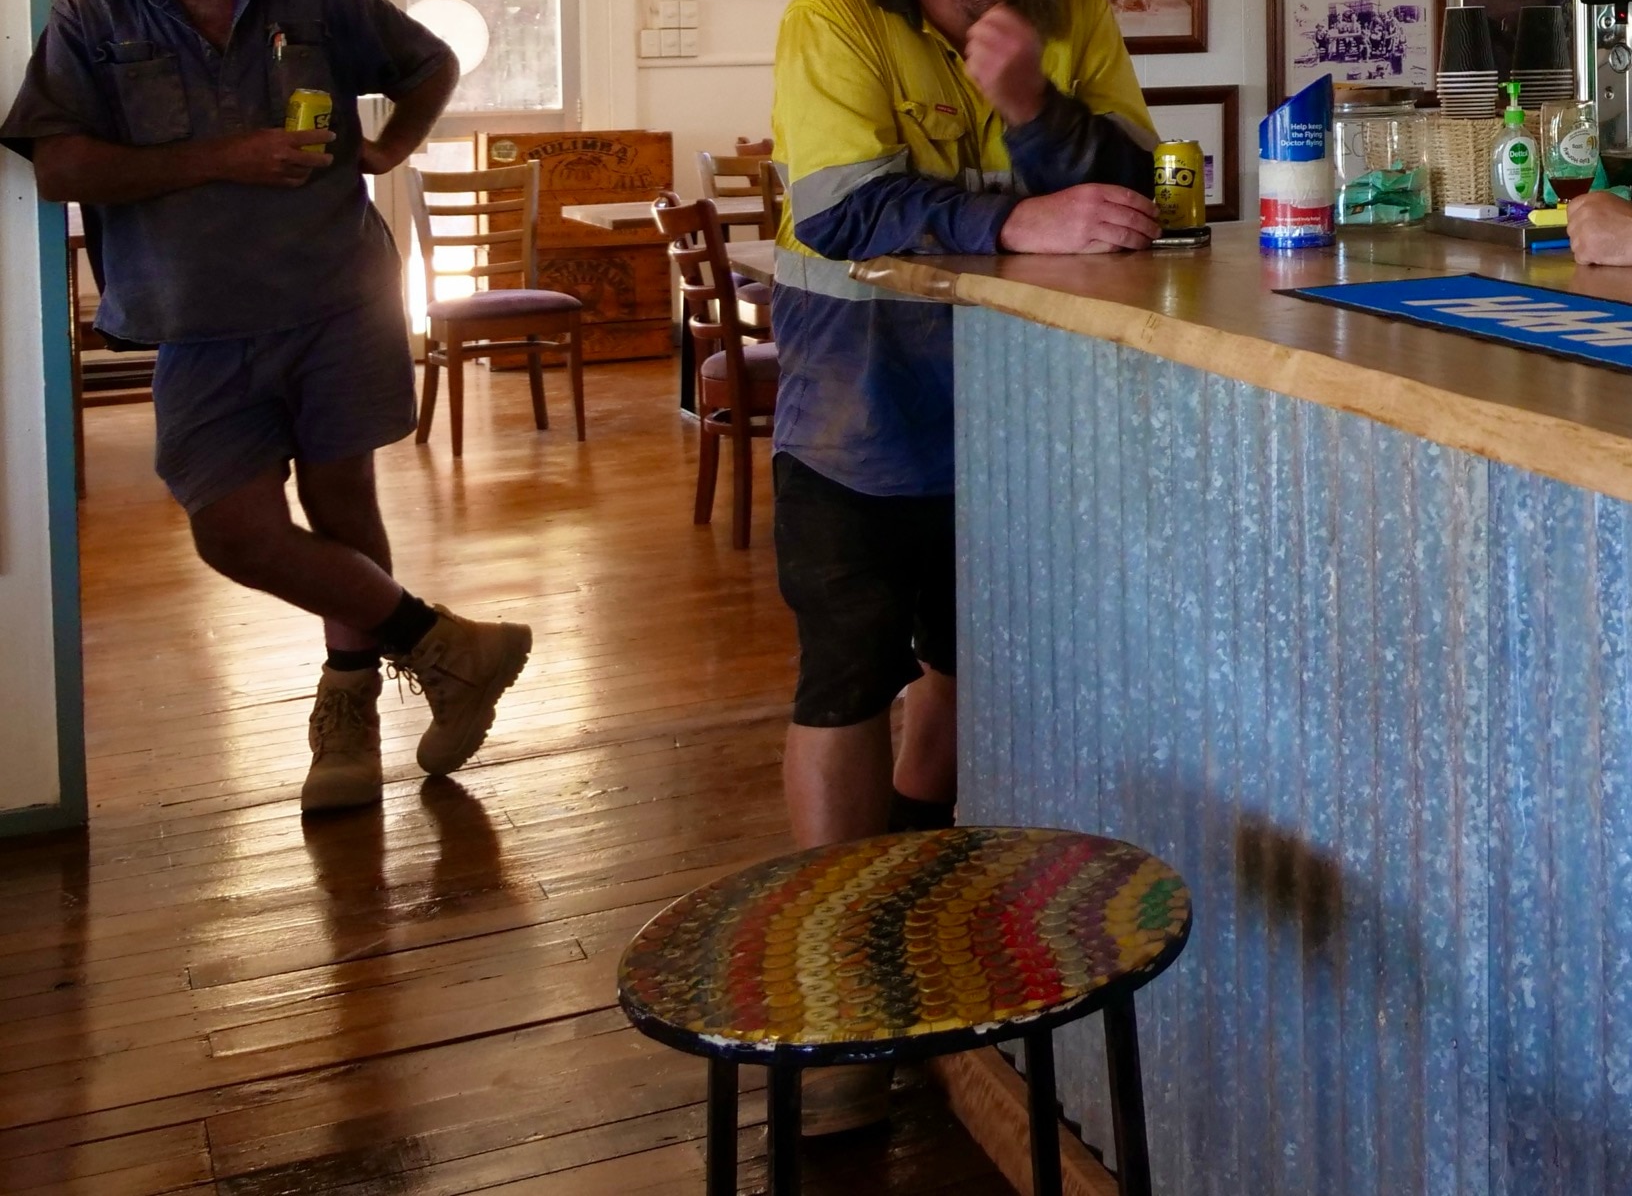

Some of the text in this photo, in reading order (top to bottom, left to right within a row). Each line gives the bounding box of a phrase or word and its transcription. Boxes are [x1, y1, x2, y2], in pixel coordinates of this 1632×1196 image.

[1290, 123, 1323, 131] Help keep
[1304, 131, 1323, 139] Flying
[1306, 139, 1323, 147] flying
[527, 136, 630, 161] BULIMBA
[1509, 150, 1528, 158] Dettol
[1154, 168, 1194, 187] OLO
